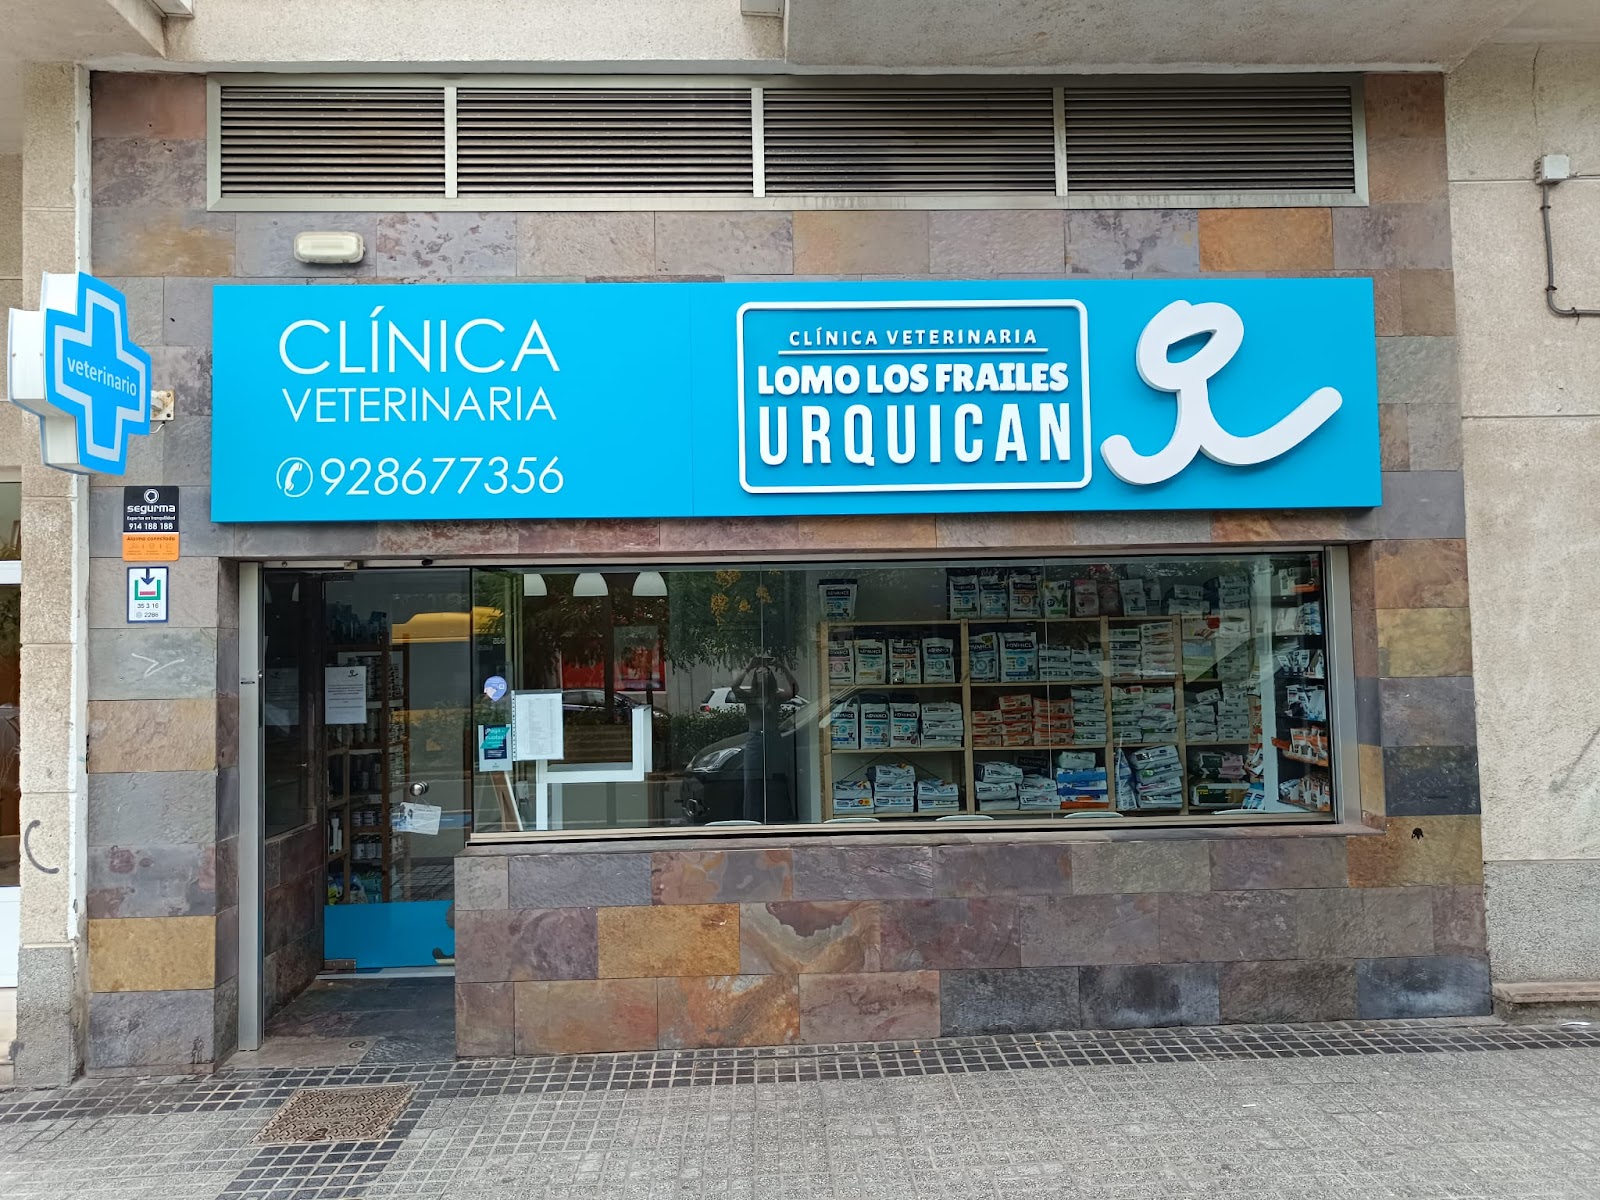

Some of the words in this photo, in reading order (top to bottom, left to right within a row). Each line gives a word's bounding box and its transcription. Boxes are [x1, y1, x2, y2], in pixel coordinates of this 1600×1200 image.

[278, 305, 561, 375] CLÍNICA
[789, 326, 878, 347] CLÍNICA
[886, 328, 1038, 346] VETERINARIA
[66, 356, 137, 397] veterinario
[757, 364, 861, 395] LOMO
[867, 362, 929, 394] LOS
[935, 361, 1069, 393] FRAILES
[281, 385, 557, 423] VETERINARIA
[758, 402, 1071, 467] URQUICAN
[320, 455, 565, 496] 928677356
[126, 504, 176, 515] segurma
[128, 522, 142, 530] 914
[144, 522, 158, 530] 188
[160, 522, 174, 530] 188
